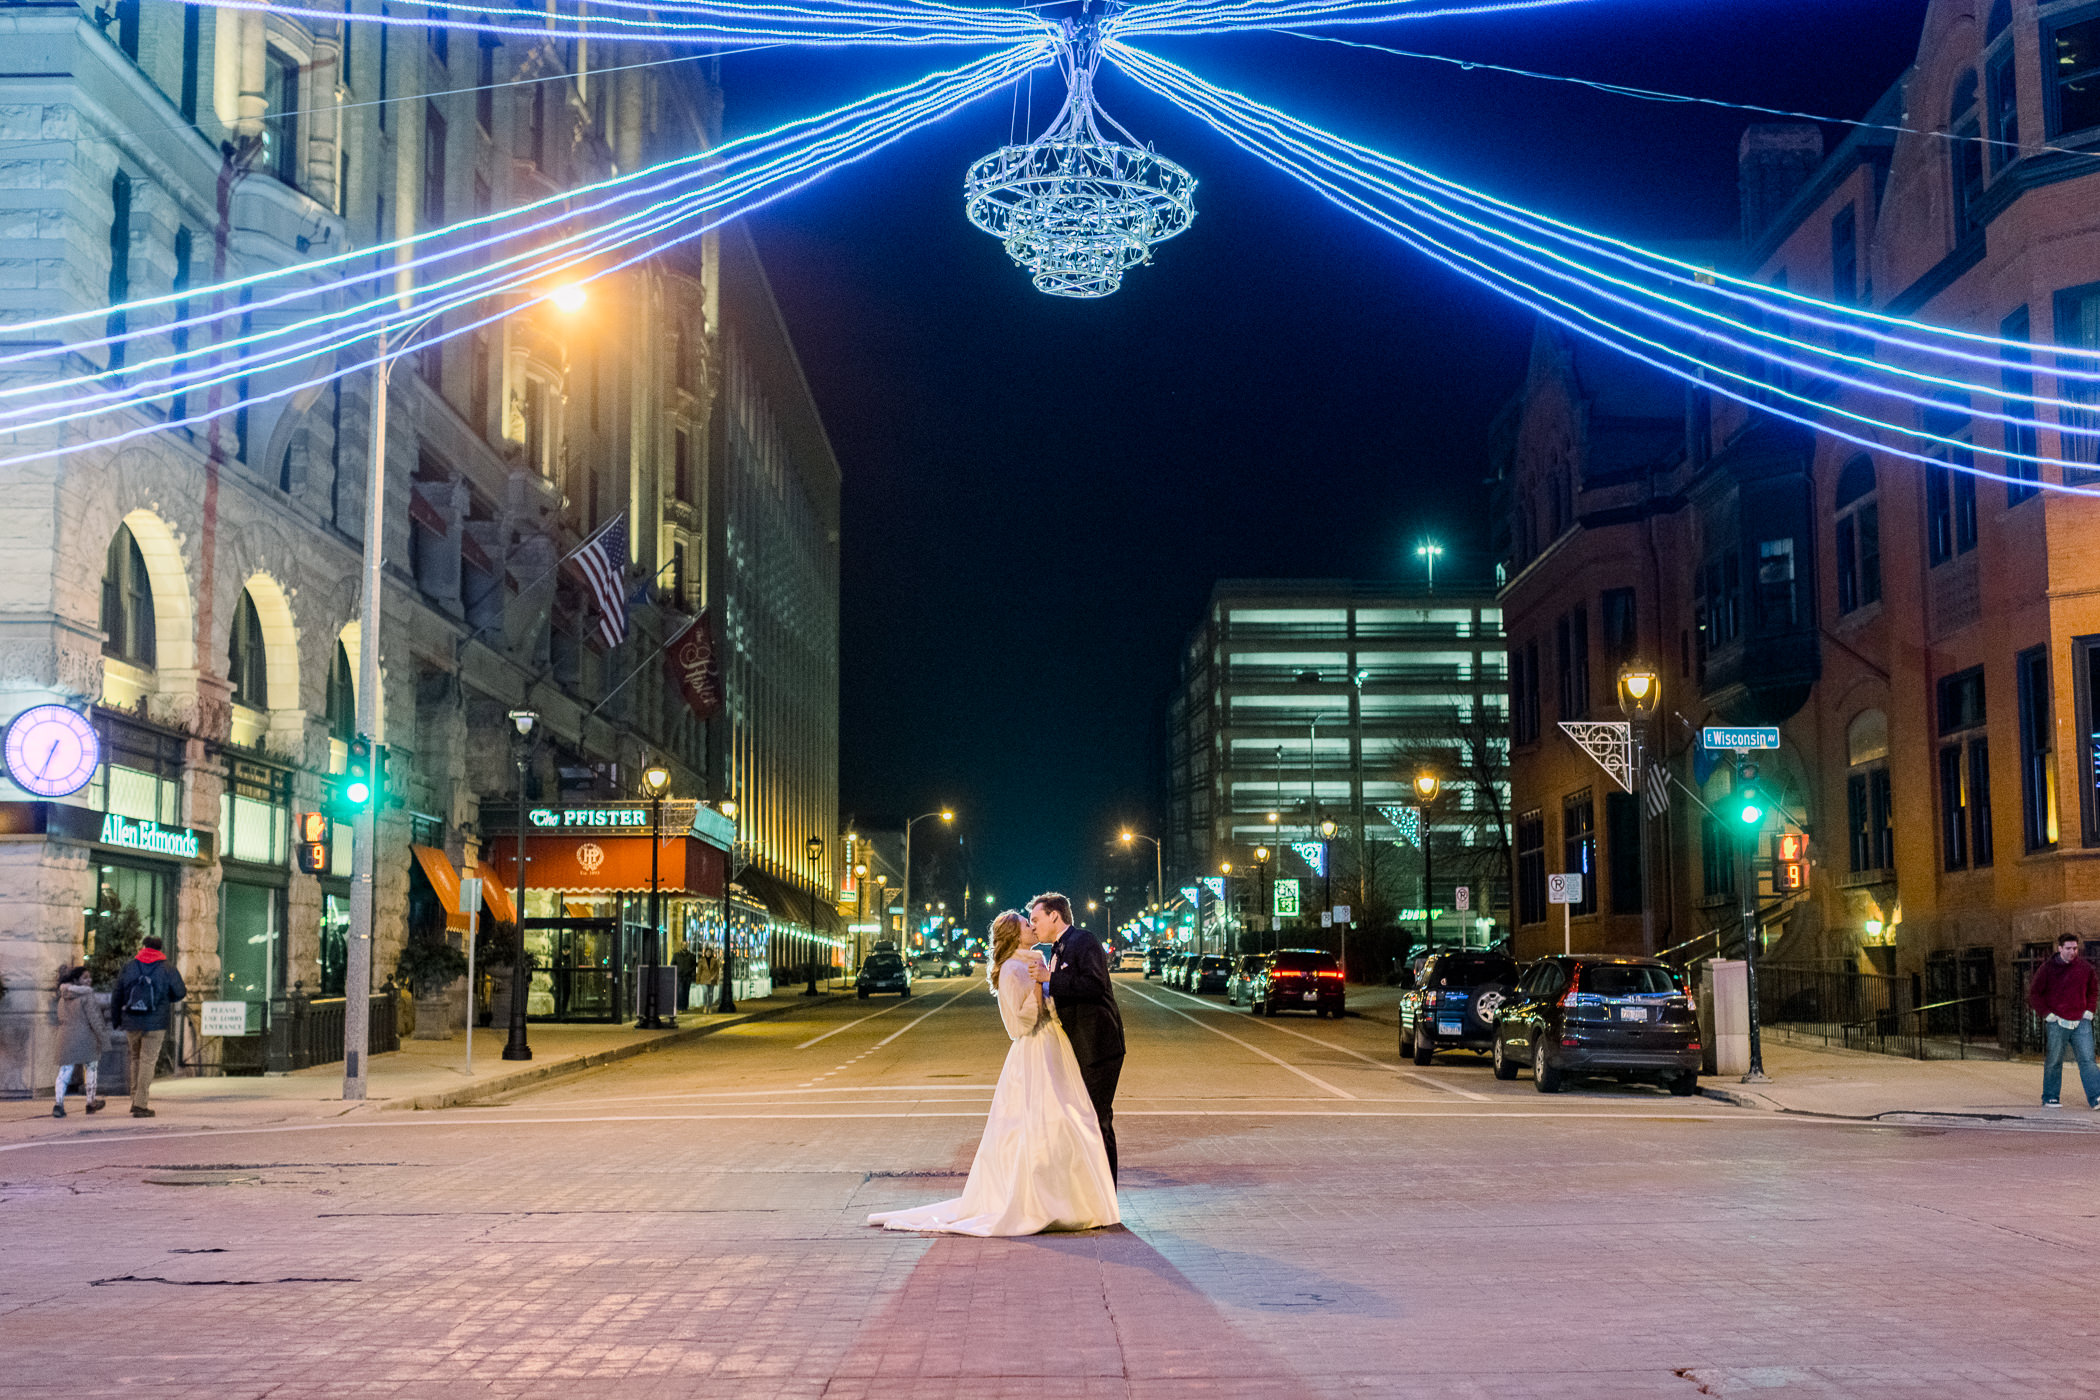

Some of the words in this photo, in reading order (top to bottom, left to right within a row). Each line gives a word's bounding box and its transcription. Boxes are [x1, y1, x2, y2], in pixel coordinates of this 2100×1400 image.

[1707, 733, 1712, 742] E
[1713, 730, 1766, 746] Wisconsin
[1767, 734, 1776, 743] AV
[529, 809, 560, 827] The
[563, 809, 646, 826] PFISTER
[100, 813, 138, 848] Allen
[138, 820, 199, 859] Edmonds
[1399, 908, 1443, 920] SUBWY
